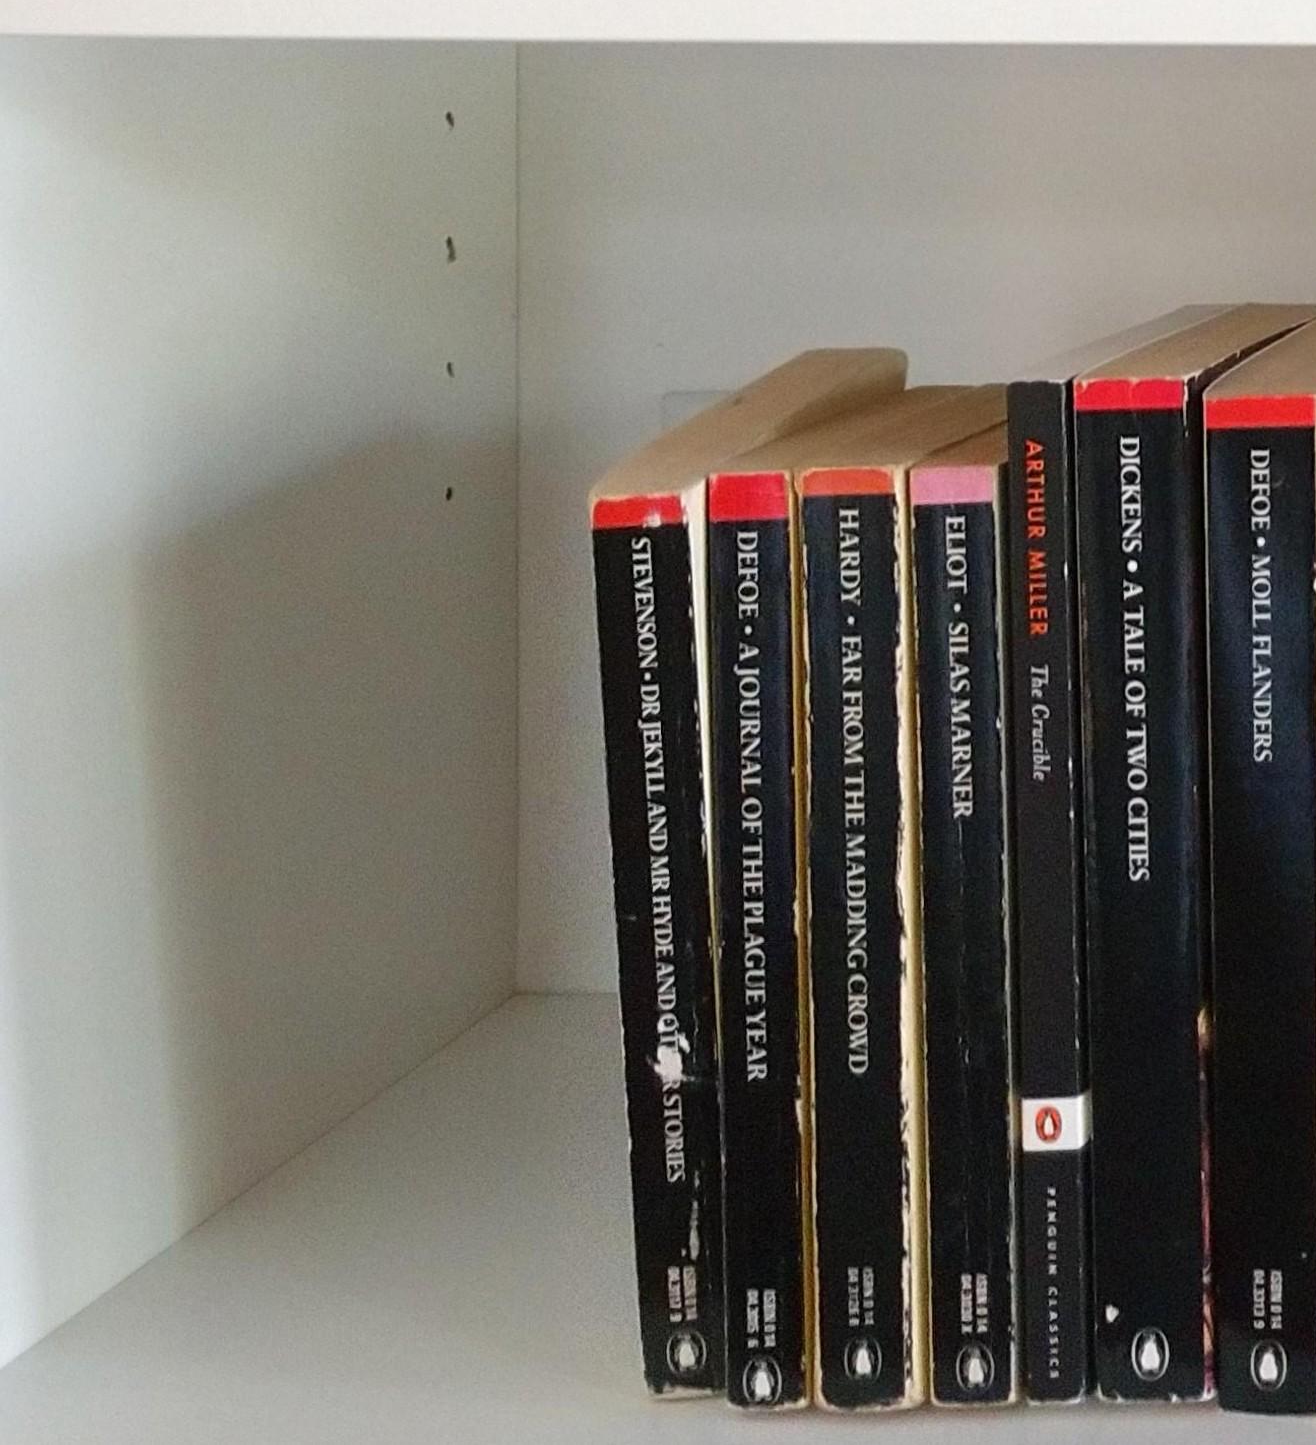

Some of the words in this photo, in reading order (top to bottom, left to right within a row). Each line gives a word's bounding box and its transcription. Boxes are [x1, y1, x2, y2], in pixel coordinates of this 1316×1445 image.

[1024, 439, 1047, 540] ARTHUR
[1119, 435, 1144, 555] DICKENS
[1249, 448, 1272, 533] DEFOE
[735, 530, 760, 620] DEFOE
[838, 508, 862, 615] HARDY
[944, 516, 968, 590] ELIOT
[1026, 548, 1049, 637] MILLER
[1122, 578, 1145, 602] A
[1251, 555, 1273, 633] MOLL
[738, 641, 760, 661] A
[841, 635, 864, 687] FAR
[947, 622, 971, 694] SILAS
[1123, 604, 1147, 675] TALE
[1029, 665, 1049, 698] The
[1125, 680, 1147, 720] OF
[1251, 634, 1274, 764] FLANDERS
[733, 663, 763, 792] JOURNAL
[842, 690, 866, 765] FROM
[949, 695, 975, 820] MARNER
[1030, 703, 1053, 783] Crucible
[1126, 722, 1149, 791] TWO
[741, 796, 763, 835] OF
[844, 767, 866, 826] THE
[741, 836, 764, 898] THE
[1127, 795, 1150, 883] CITIES
[844, 831, 870, 970] MADDING
[742, 900, 768, 1003] PLAGUE
[745, 1004, 769, 1083] YEAR
[846, 970, 870, 1075] CROWD
[1046, 1186, 1057, 1276] PENGUIN
[1047, 1286, 1061, 1380] CLASSICS
